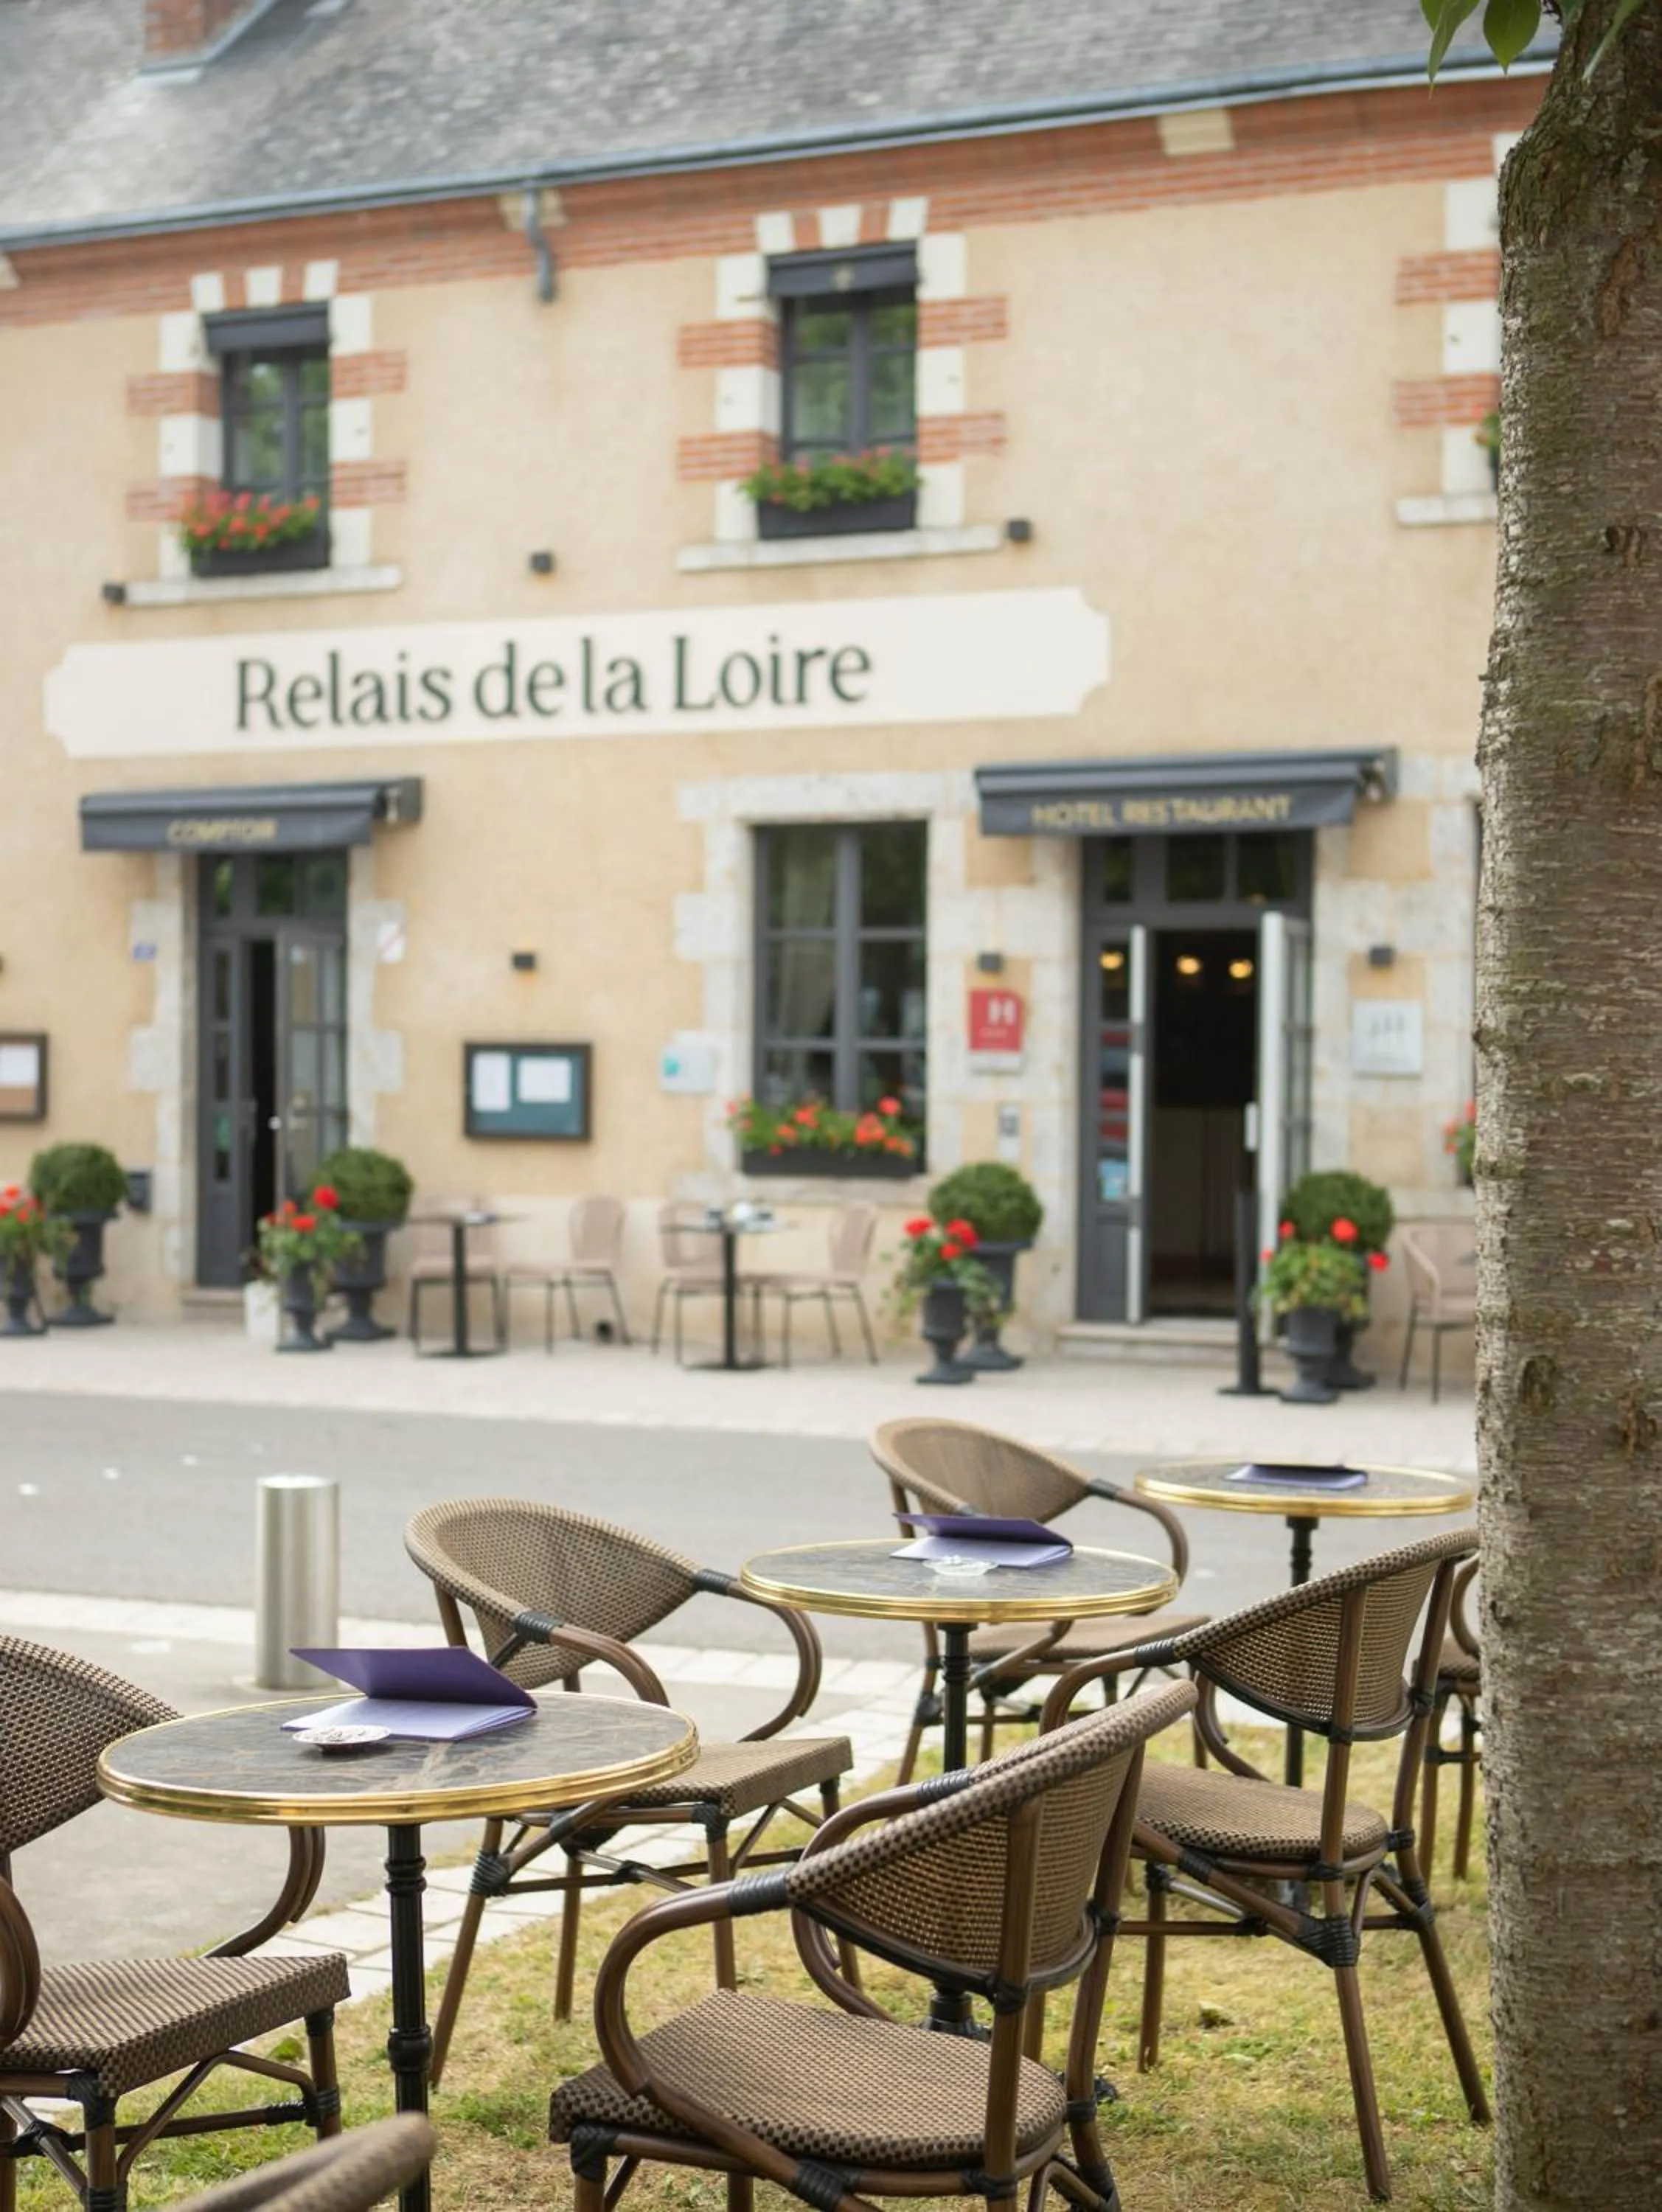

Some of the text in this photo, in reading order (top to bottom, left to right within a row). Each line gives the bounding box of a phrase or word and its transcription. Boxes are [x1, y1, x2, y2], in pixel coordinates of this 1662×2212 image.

[234, 633, 873, 734] Relais de la Loire
[1030, 793, 1293, 828] HOTEL RESTAURANT
[167, 818, 277, 846] COMPTOIR
